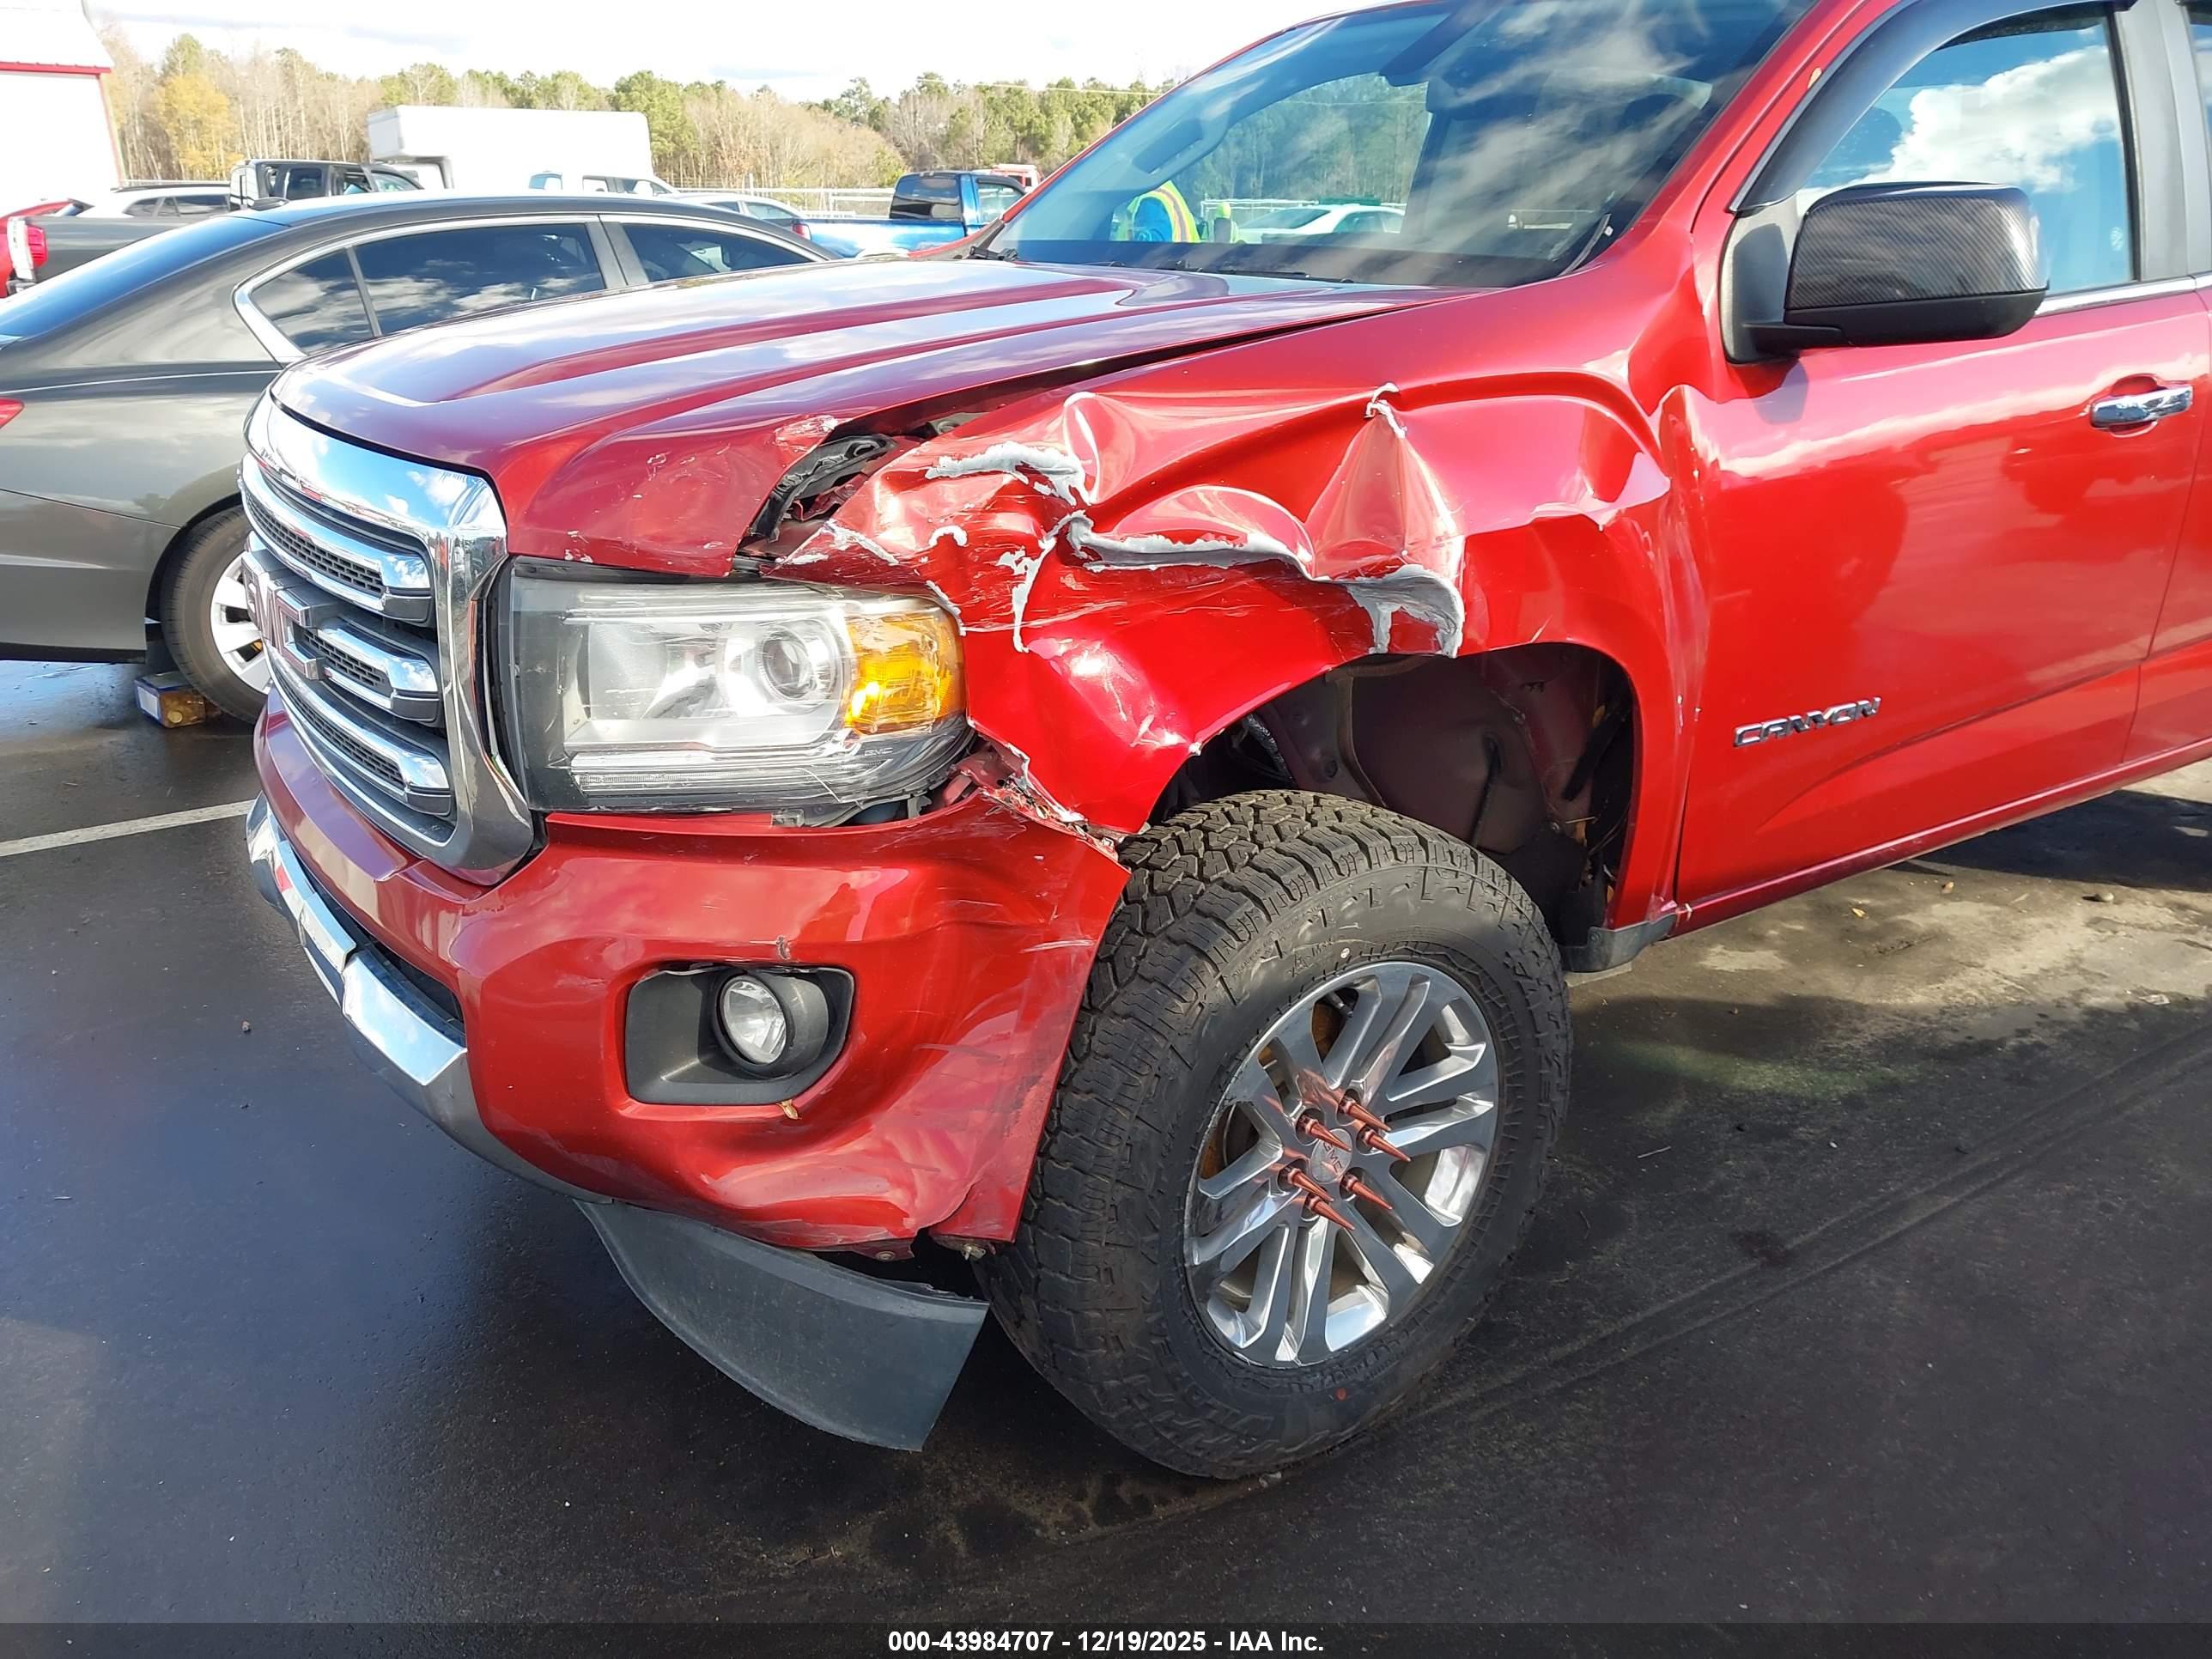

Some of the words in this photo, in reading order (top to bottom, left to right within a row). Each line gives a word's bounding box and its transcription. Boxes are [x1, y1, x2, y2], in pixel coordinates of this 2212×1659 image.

[1733, 696, 1881, 747] CANYON
[864, 747, 894, 757] GMC
[1322, 1140, 1343, 1174] GMC
